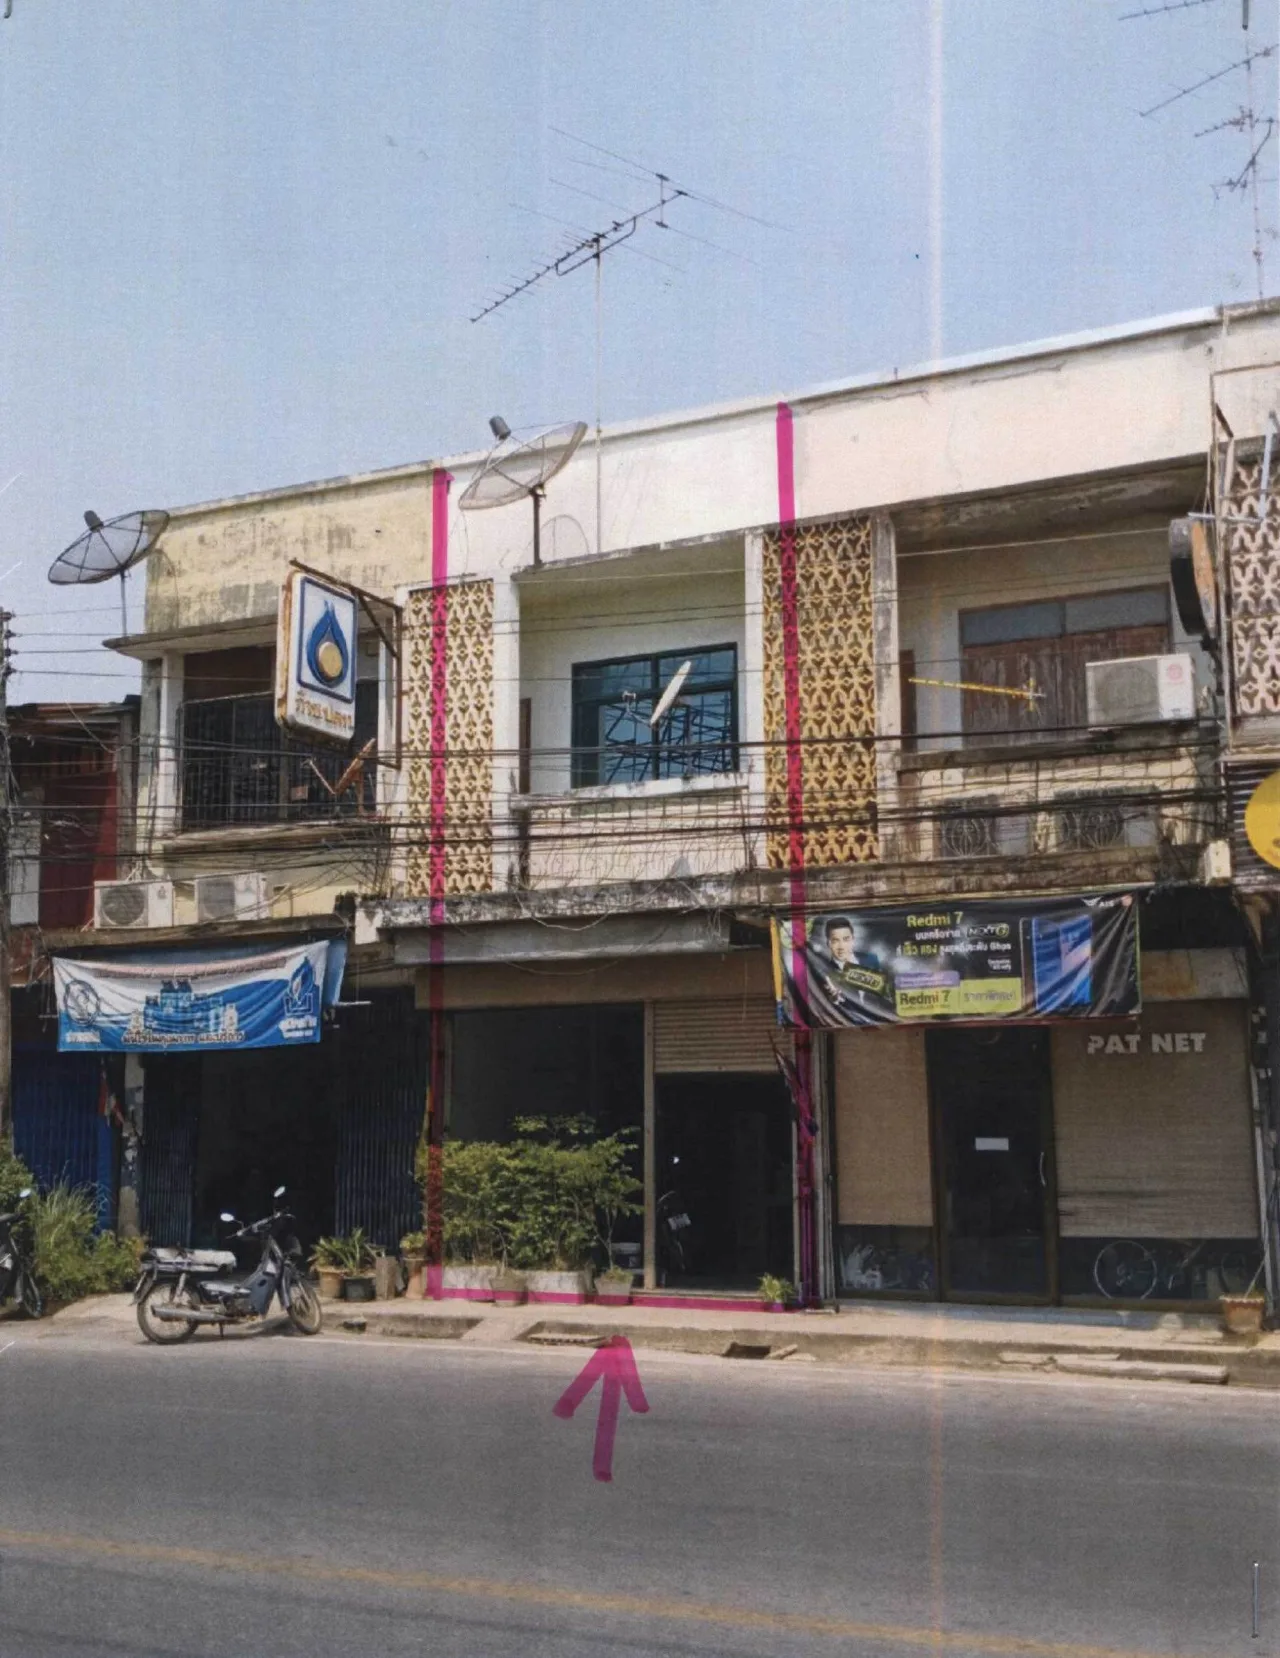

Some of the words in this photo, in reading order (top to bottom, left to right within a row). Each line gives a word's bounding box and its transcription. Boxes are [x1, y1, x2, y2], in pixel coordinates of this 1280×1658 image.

[906, 914, 951, 928] Redmi
[954, 911, 963, 924] 7
[900, 992, 939, 1004] Redmi
[941, 989, 951, 1002] 7
[1087, 1033, 1140, 1054] PAT
[1151, 1032, 1206, 1053] NET
